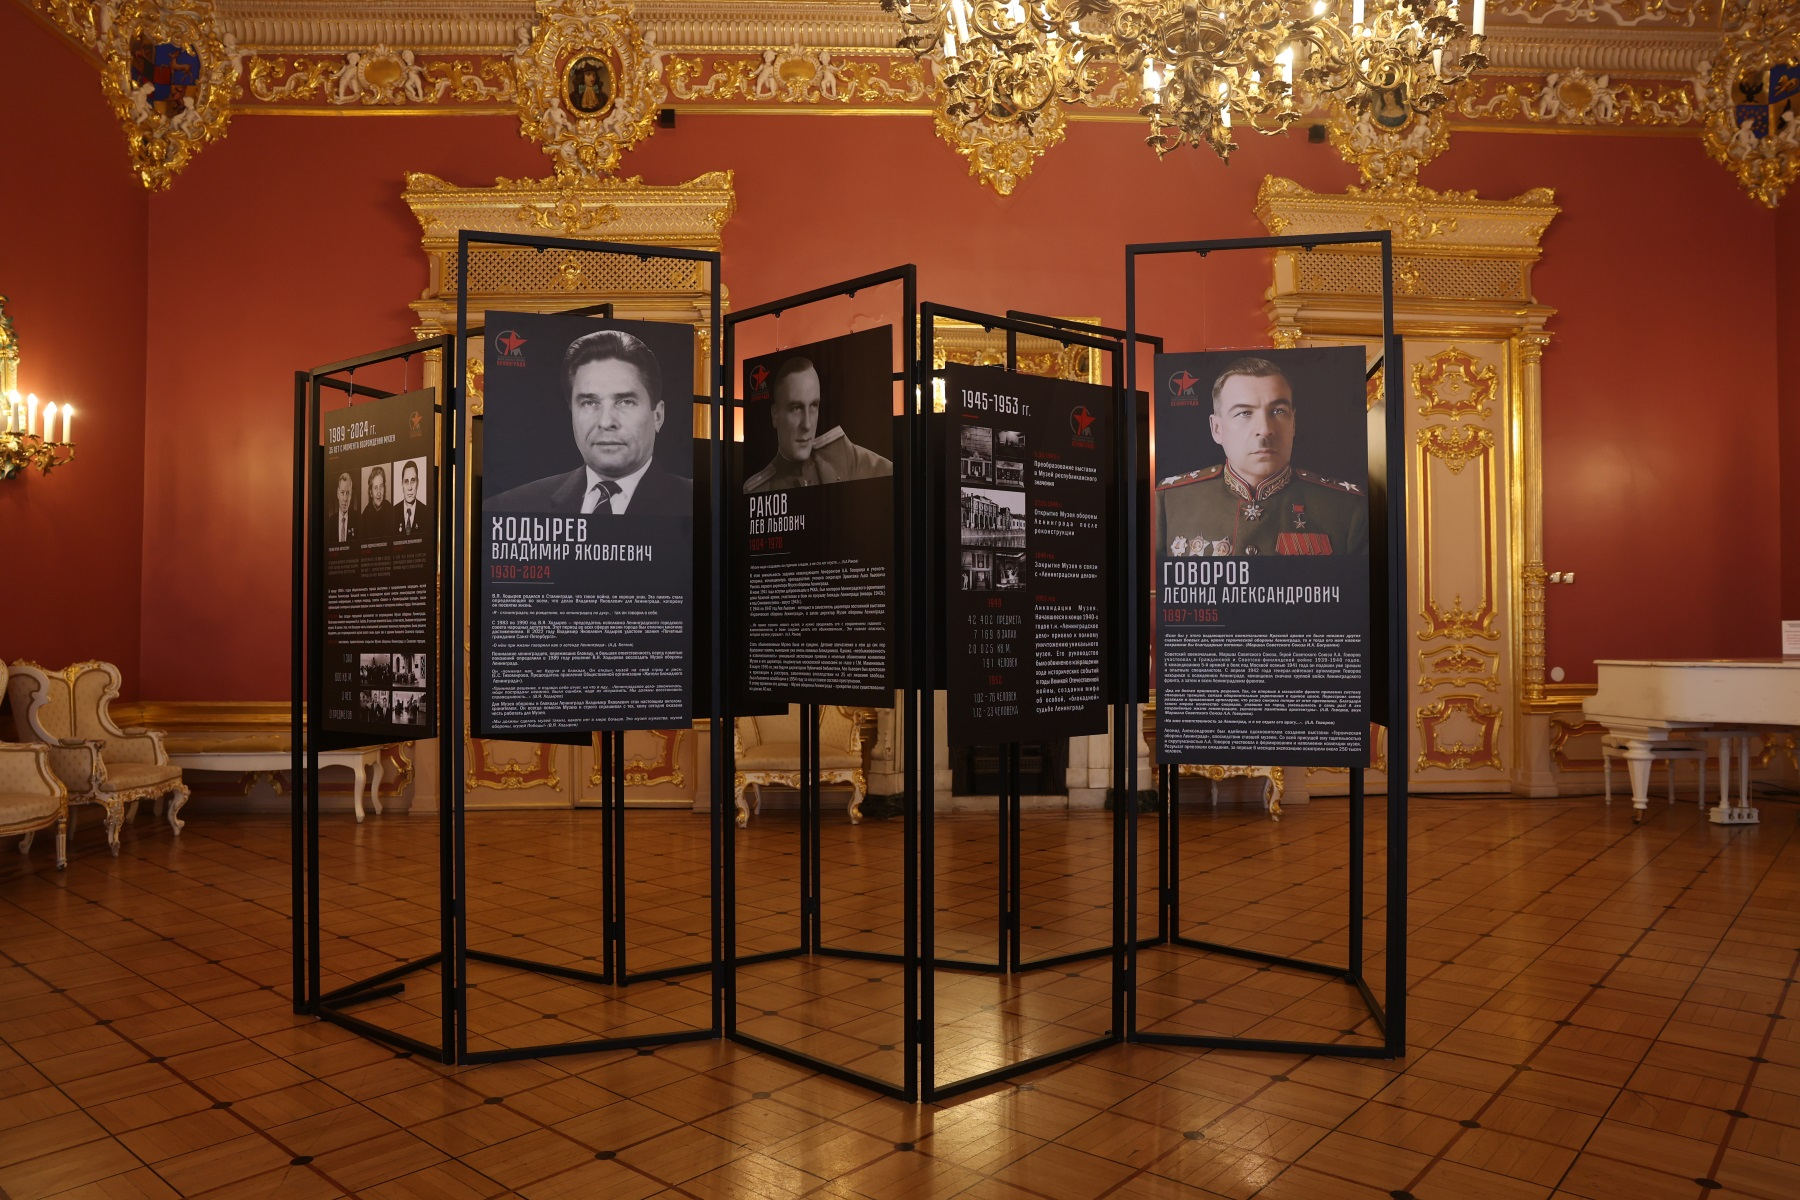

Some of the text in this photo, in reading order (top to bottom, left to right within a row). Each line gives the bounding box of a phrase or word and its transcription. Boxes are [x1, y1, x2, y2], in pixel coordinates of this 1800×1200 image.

[962, 390, 1031, 416] 1945-1953 гг.
[329, 426, 345, 443] 1989
[1039, 470, 1053, 478] Музей
[750, 493, 788, 519] РАКОВ
[750, 514, 804, 534] ЛЕВ ЛЬВОВИЧ
[1034, 519, 1073, 527] Ленинграда
[492, 517, 587, 544] ХОДЫРЕВ
[750, 536, 783, 550] 1904-1970
[492, 542, 651, 561] ВЛАДИМИР ЯКОВЛЕВИЧ
[491, 565, 550, 578] 1930-2024
[1035, 561, 1060, 569] Закрытие
[1164, 561, 1249, 585] ГОВОРОВ
[1164, 586, 1339, 605] ЛЕОНИД АЛЕКСАНДРОВИЧ
[968, 615, 1021, 625] 42 402 ПРЕДМЕТА
[1163, 609, 1218, 622] 1897-1955
[981, 630, 993, 639] 169
[969, 644, 976, 654] 20
[981, 644, 993, 653] 025
